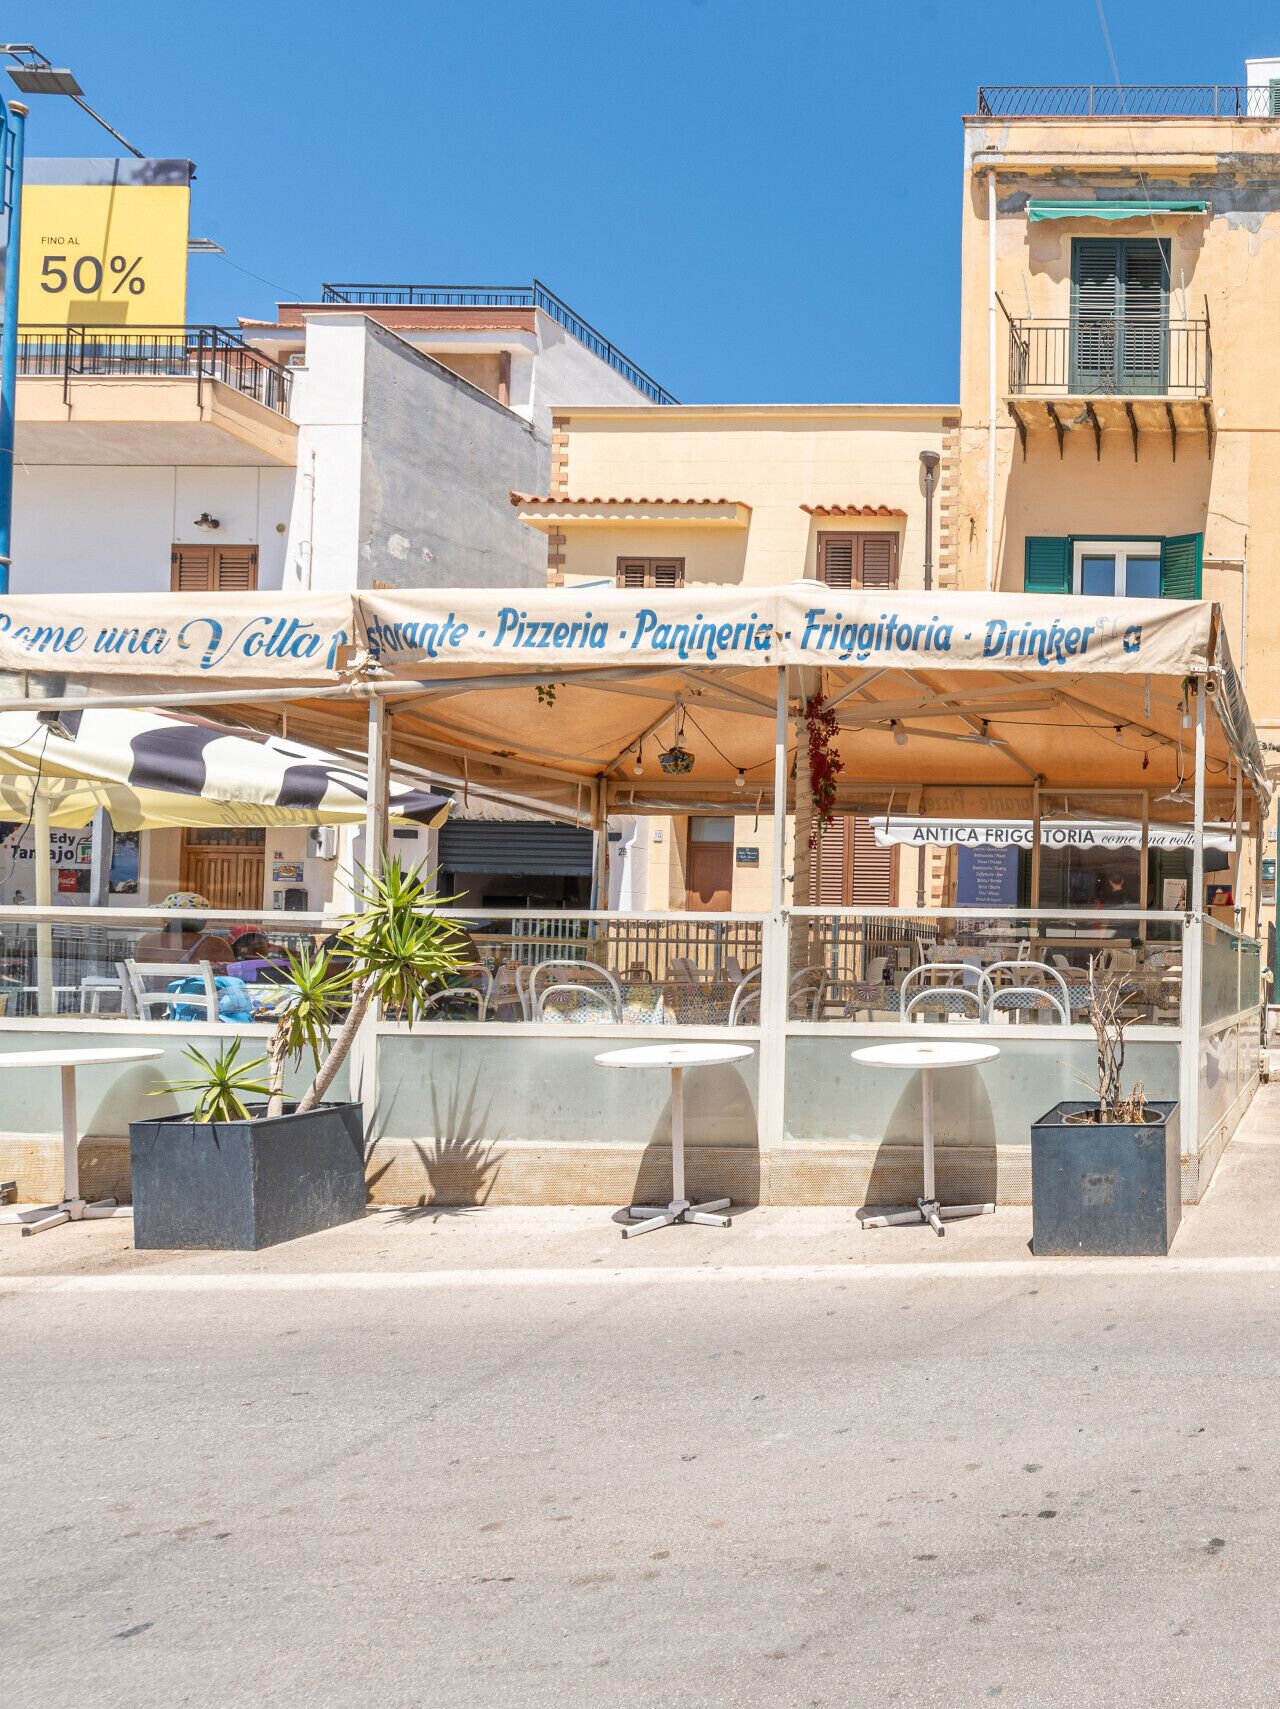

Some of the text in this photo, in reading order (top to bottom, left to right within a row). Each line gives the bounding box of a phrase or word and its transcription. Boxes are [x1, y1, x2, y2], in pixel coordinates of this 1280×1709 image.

[41, 236, 81, 246] FINO AL
[40, 255, 146, 295] 50%
[0, 612, 88, 653] ome
[94, 626, 171, 655] una
[177, 616, 324, 669] Volta
[366, 612, 469, 658] storante
[493, 606, 609, 649] Pizzeria
[630, 608, 774, 661] Panineria
[800, 608, 953, 662] Friggitoria
[50, 832, 76, 847] Edy
[912, 826, 1195, 846] ANTICA FRIGGTORIA come na volt
